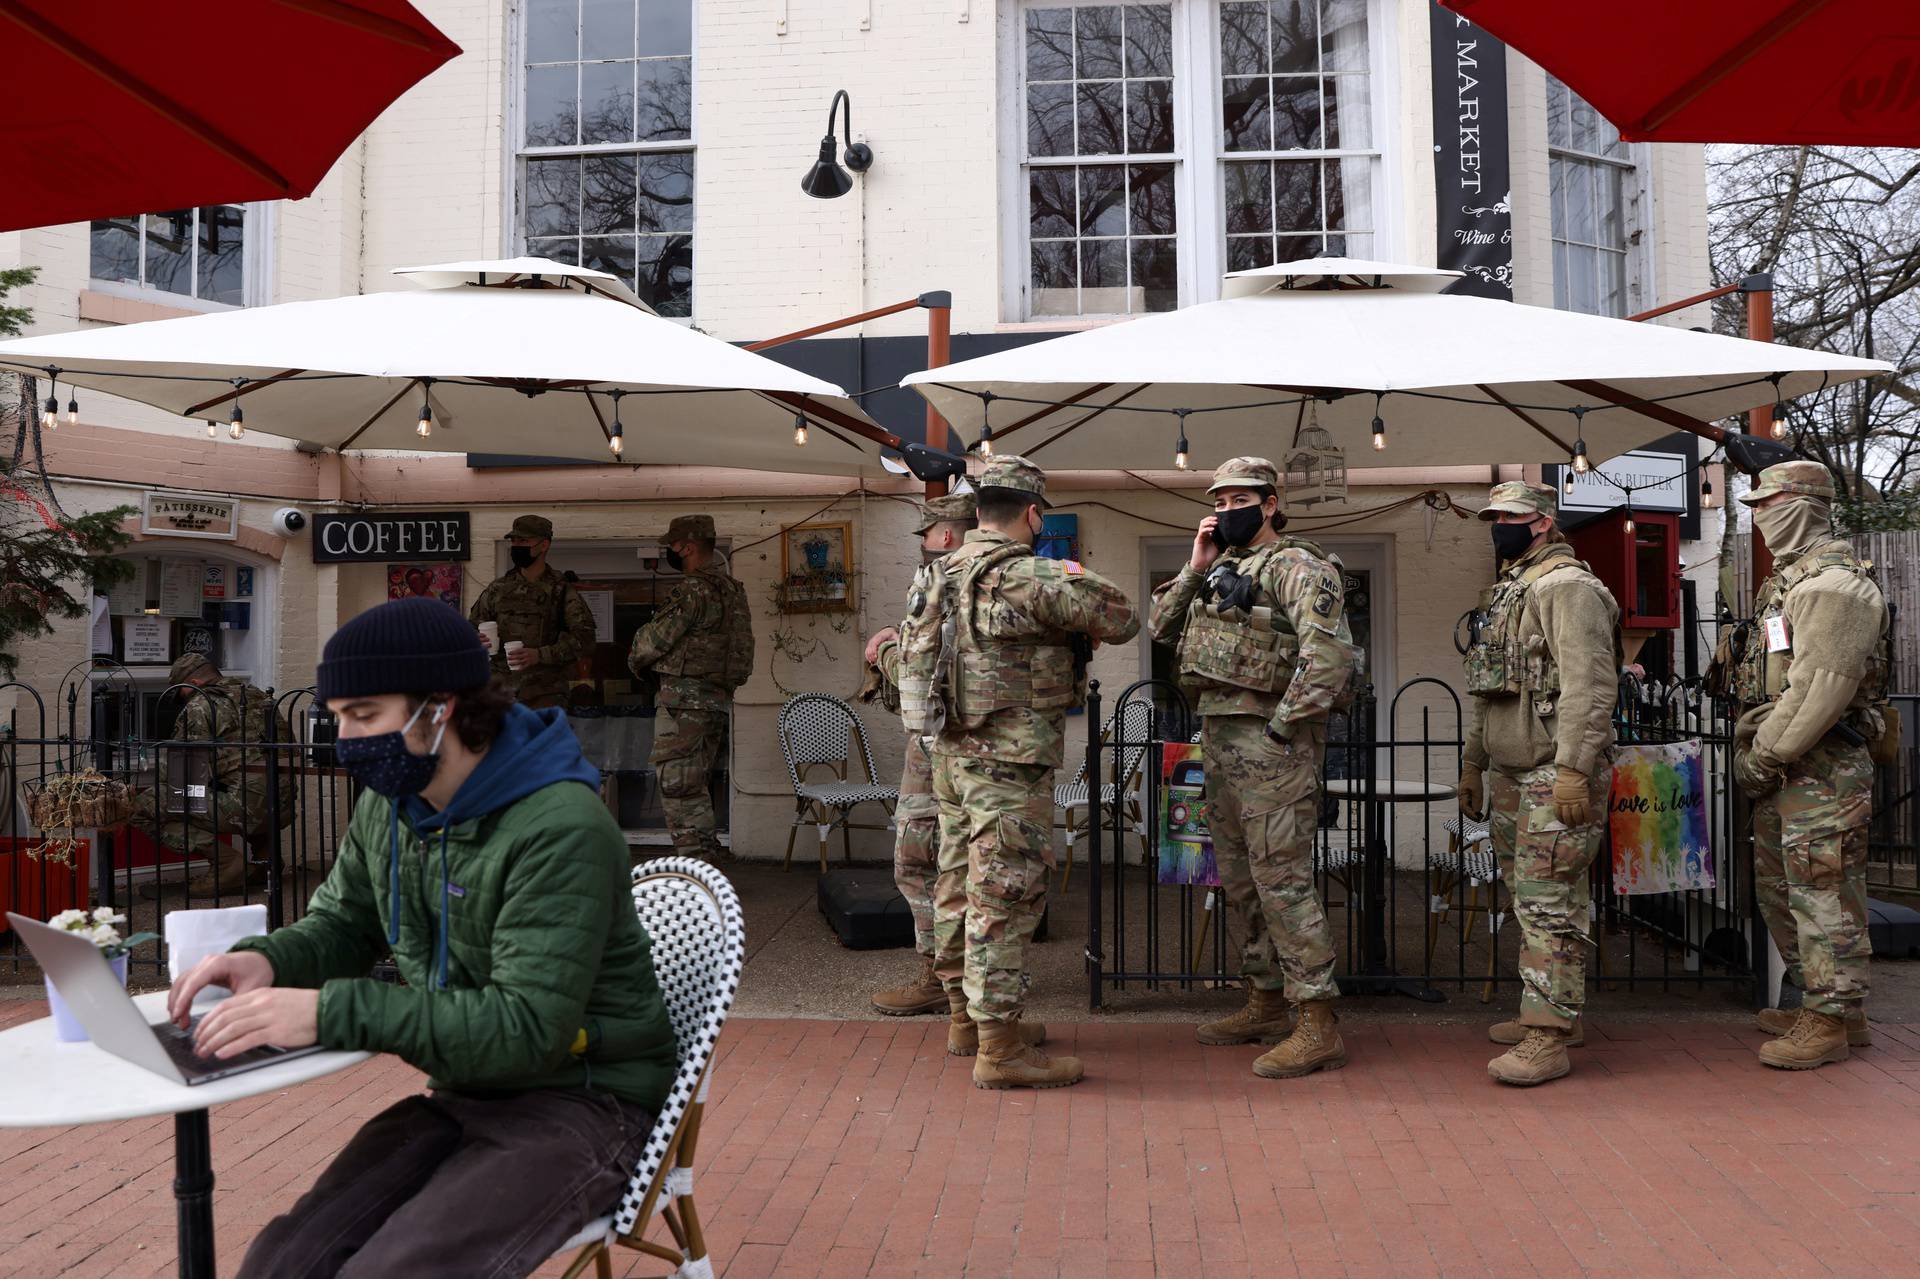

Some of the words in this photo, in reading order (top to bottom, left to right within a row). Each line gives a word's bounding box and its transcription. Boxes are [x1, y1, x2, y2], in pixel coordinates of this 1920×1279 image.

[1456, 39, 1481, 195] MARKET
[1454, 229, 1496, 246] Wine
[1575, 471, 1611, 488] WINE
[1613, 472, 1624, 488] &
[1625, 472, 1674, 491] BUTTER
[322, 520, 462, 554] COFFEE
[1321, 576, 1340, 593] MP
[1653, 796, 1667, 813] is
